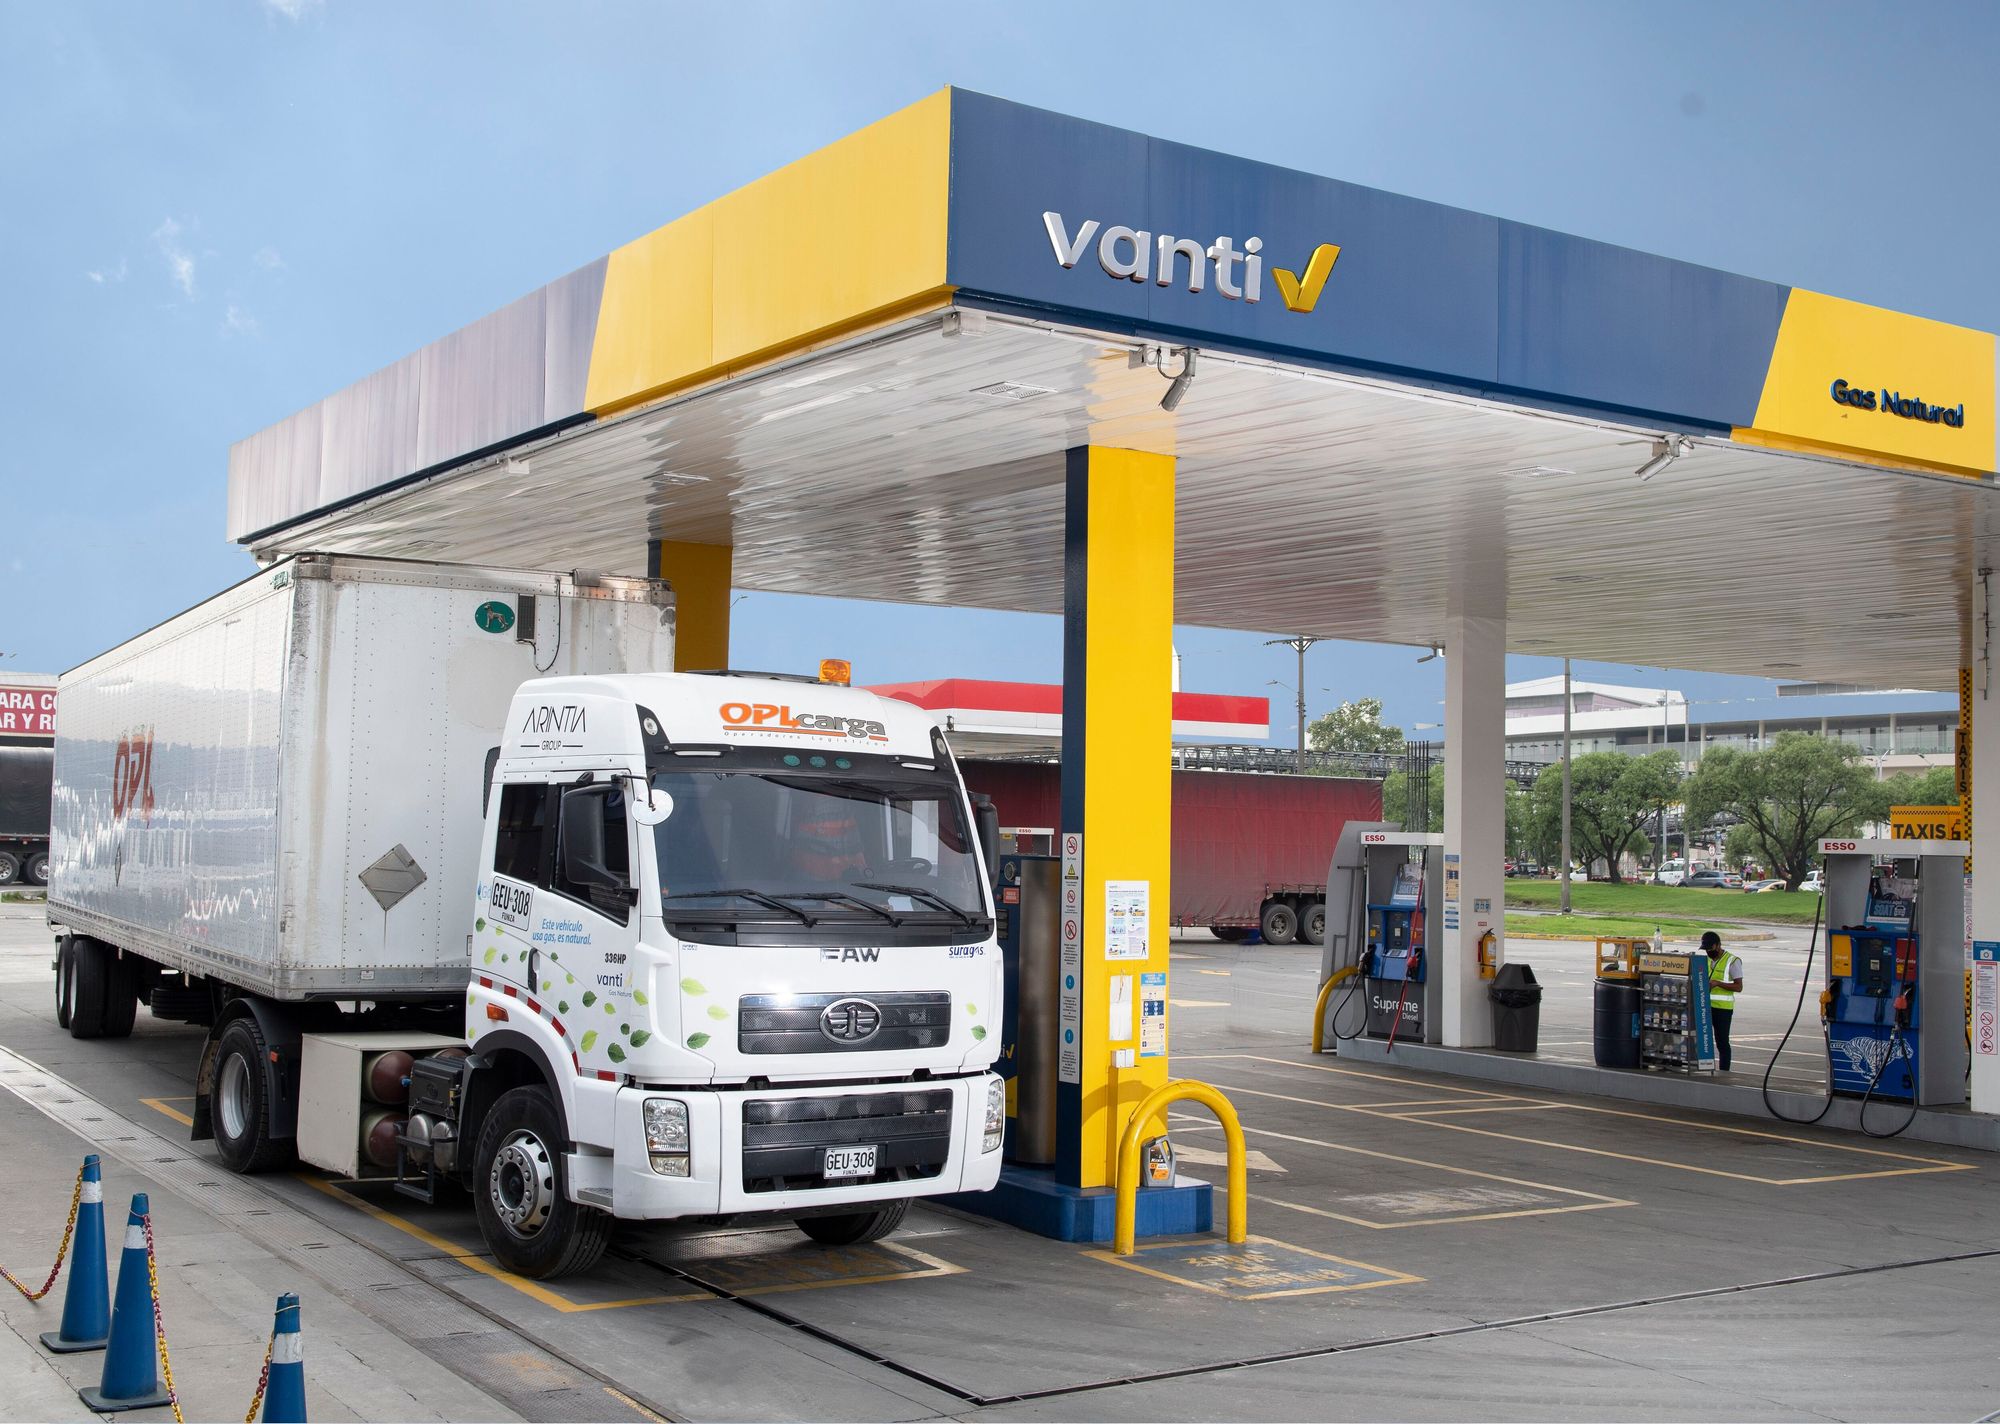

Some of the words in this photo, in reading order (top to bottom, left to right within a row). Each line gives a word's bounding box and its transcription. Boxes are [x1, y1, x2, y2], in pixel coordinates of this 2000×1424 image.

[1042, 210, 1264, 304] vanti
[1830, 378, 1877, 410] Gas
[1881, 388, 1965, 429] Natural
[0, 712, 16, 729] R
[21, 713, 35, 730] Y
[522, 705, 586, 733] ARINTIA
[541, 740, 562, 751] GROUP
[1958, 732, 1968, 793] TAXIS
[113, 730, 155, 823] OPL
[1364, 834, 1386, 842] ESSO
[1893, 823, 1947, 840] TAXIS
[1824, 842, 1856, 851] ESSO
[501, 911, 515, 923] FUNZA
[541, 918, 555, 930] Este
[532, 932, 543, 941] usa
[544, 933, 557, 944] gas,
[557, 934, 564, 943] es
[565, 933, 592, 945] natural.
[604, 952, 627, 965] 336HP
[1643, 959, 1661, 967] Mobil
[1661, 960, 1685, 969] Delvac
[596, 973, 623, 988] vanti
[1373, 995, 1418, 1014] Supreme
[1402, 1012, 1419, 1021] Diesel
